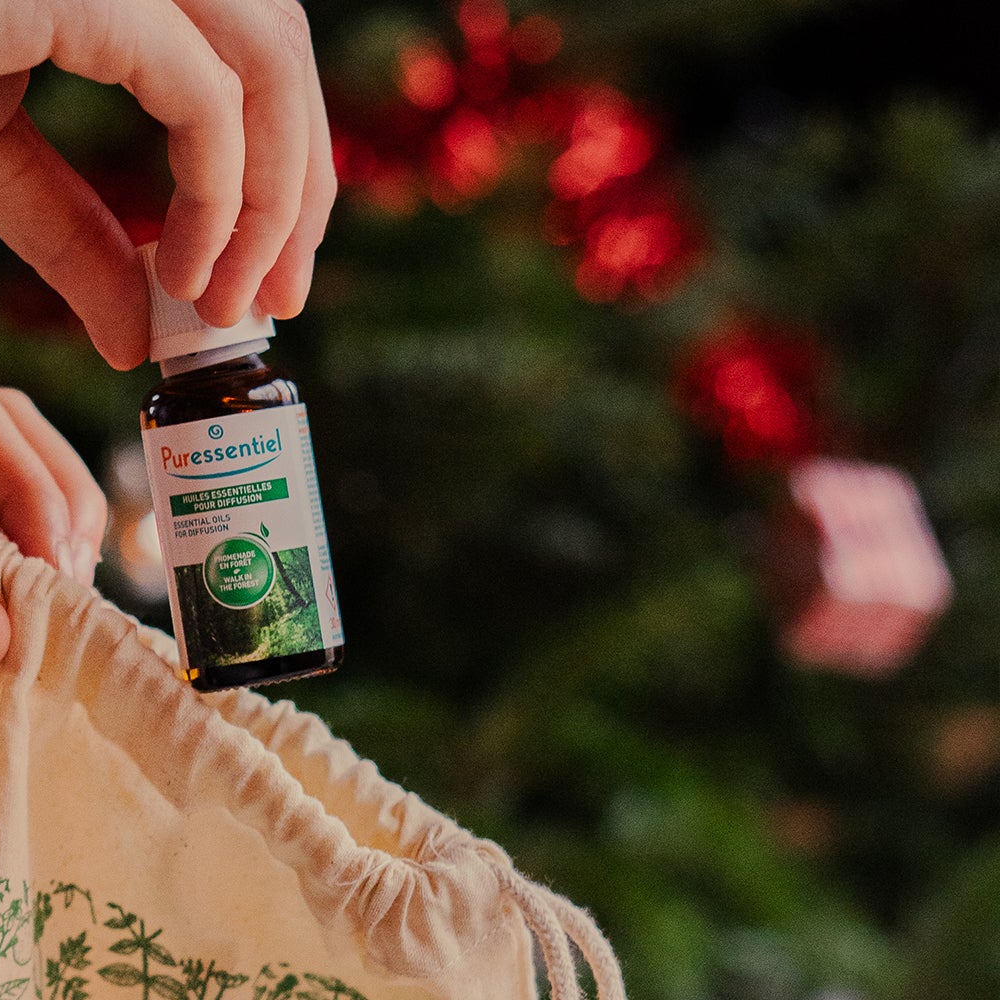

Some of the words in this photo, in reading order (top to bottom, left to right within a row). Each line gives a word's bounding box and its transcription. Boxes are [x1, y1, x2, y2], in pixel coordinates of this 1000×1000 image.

[161, 428, 282, 470] Puressentiel
[183, 492, 210, 504] HUILES
[211, 482, 272, 498] ESSENTIELLES
[194, 501, 215, 511] POUR
[217, 493, 263, 508] DIFFUSION
[174, 517, 211, 529] ESSENTIAL
[212, 514, 230, 523] OILS
[175, 529, 187, 538] FOR
[188, 524, 229, 537] DIFFUSION
[219, 584, 232, 592] THE
[233, 579, 259, 590] FOREST
[223, 574, 244, 583] WALK
